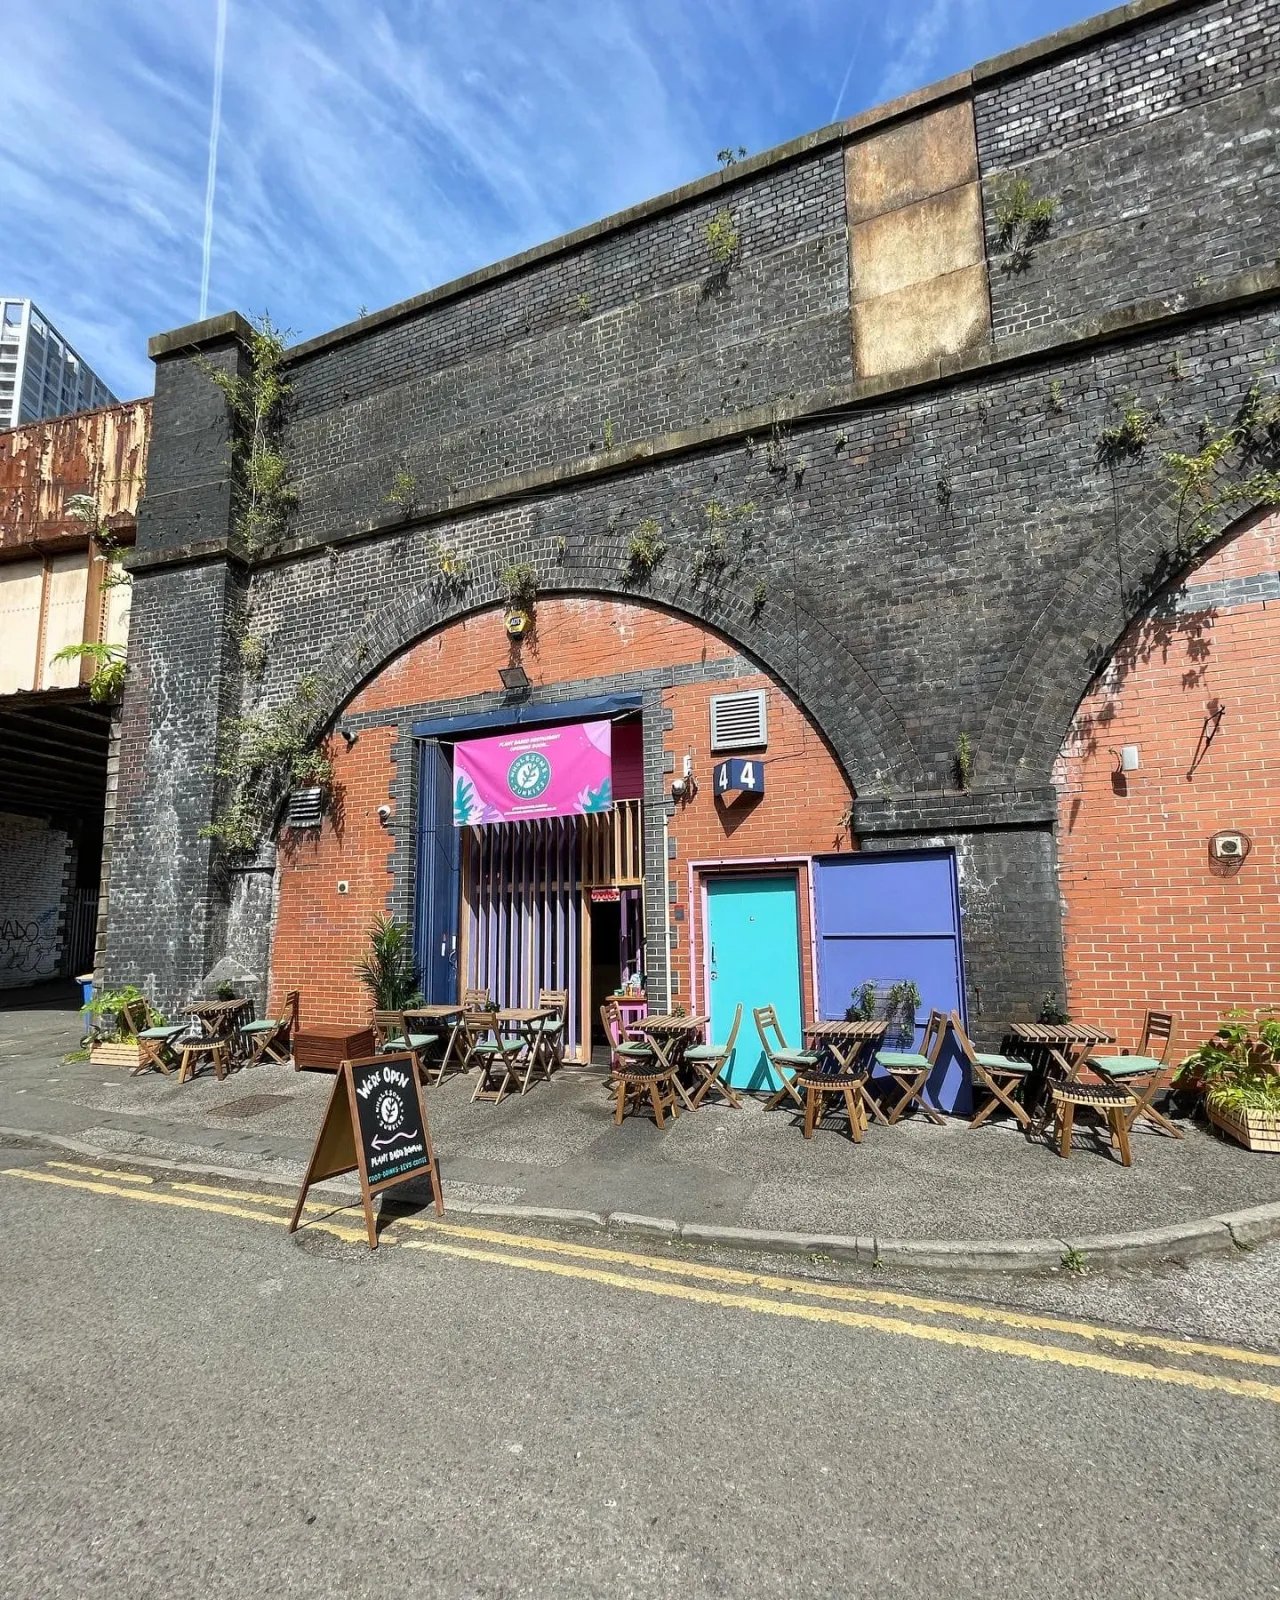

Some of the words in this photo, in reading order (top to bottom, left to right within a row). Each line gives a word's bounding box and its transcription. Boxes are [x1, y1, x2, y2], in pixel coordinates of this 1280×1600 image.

[511, 755, 548, 778] WHOLESOME
[719, 763, 728, 790] 4
[740, 761, 756, 789] 4
[512, 781, 545, 796] JUNKIES
[375, 1089, 404, 1113] WHOLESOME
